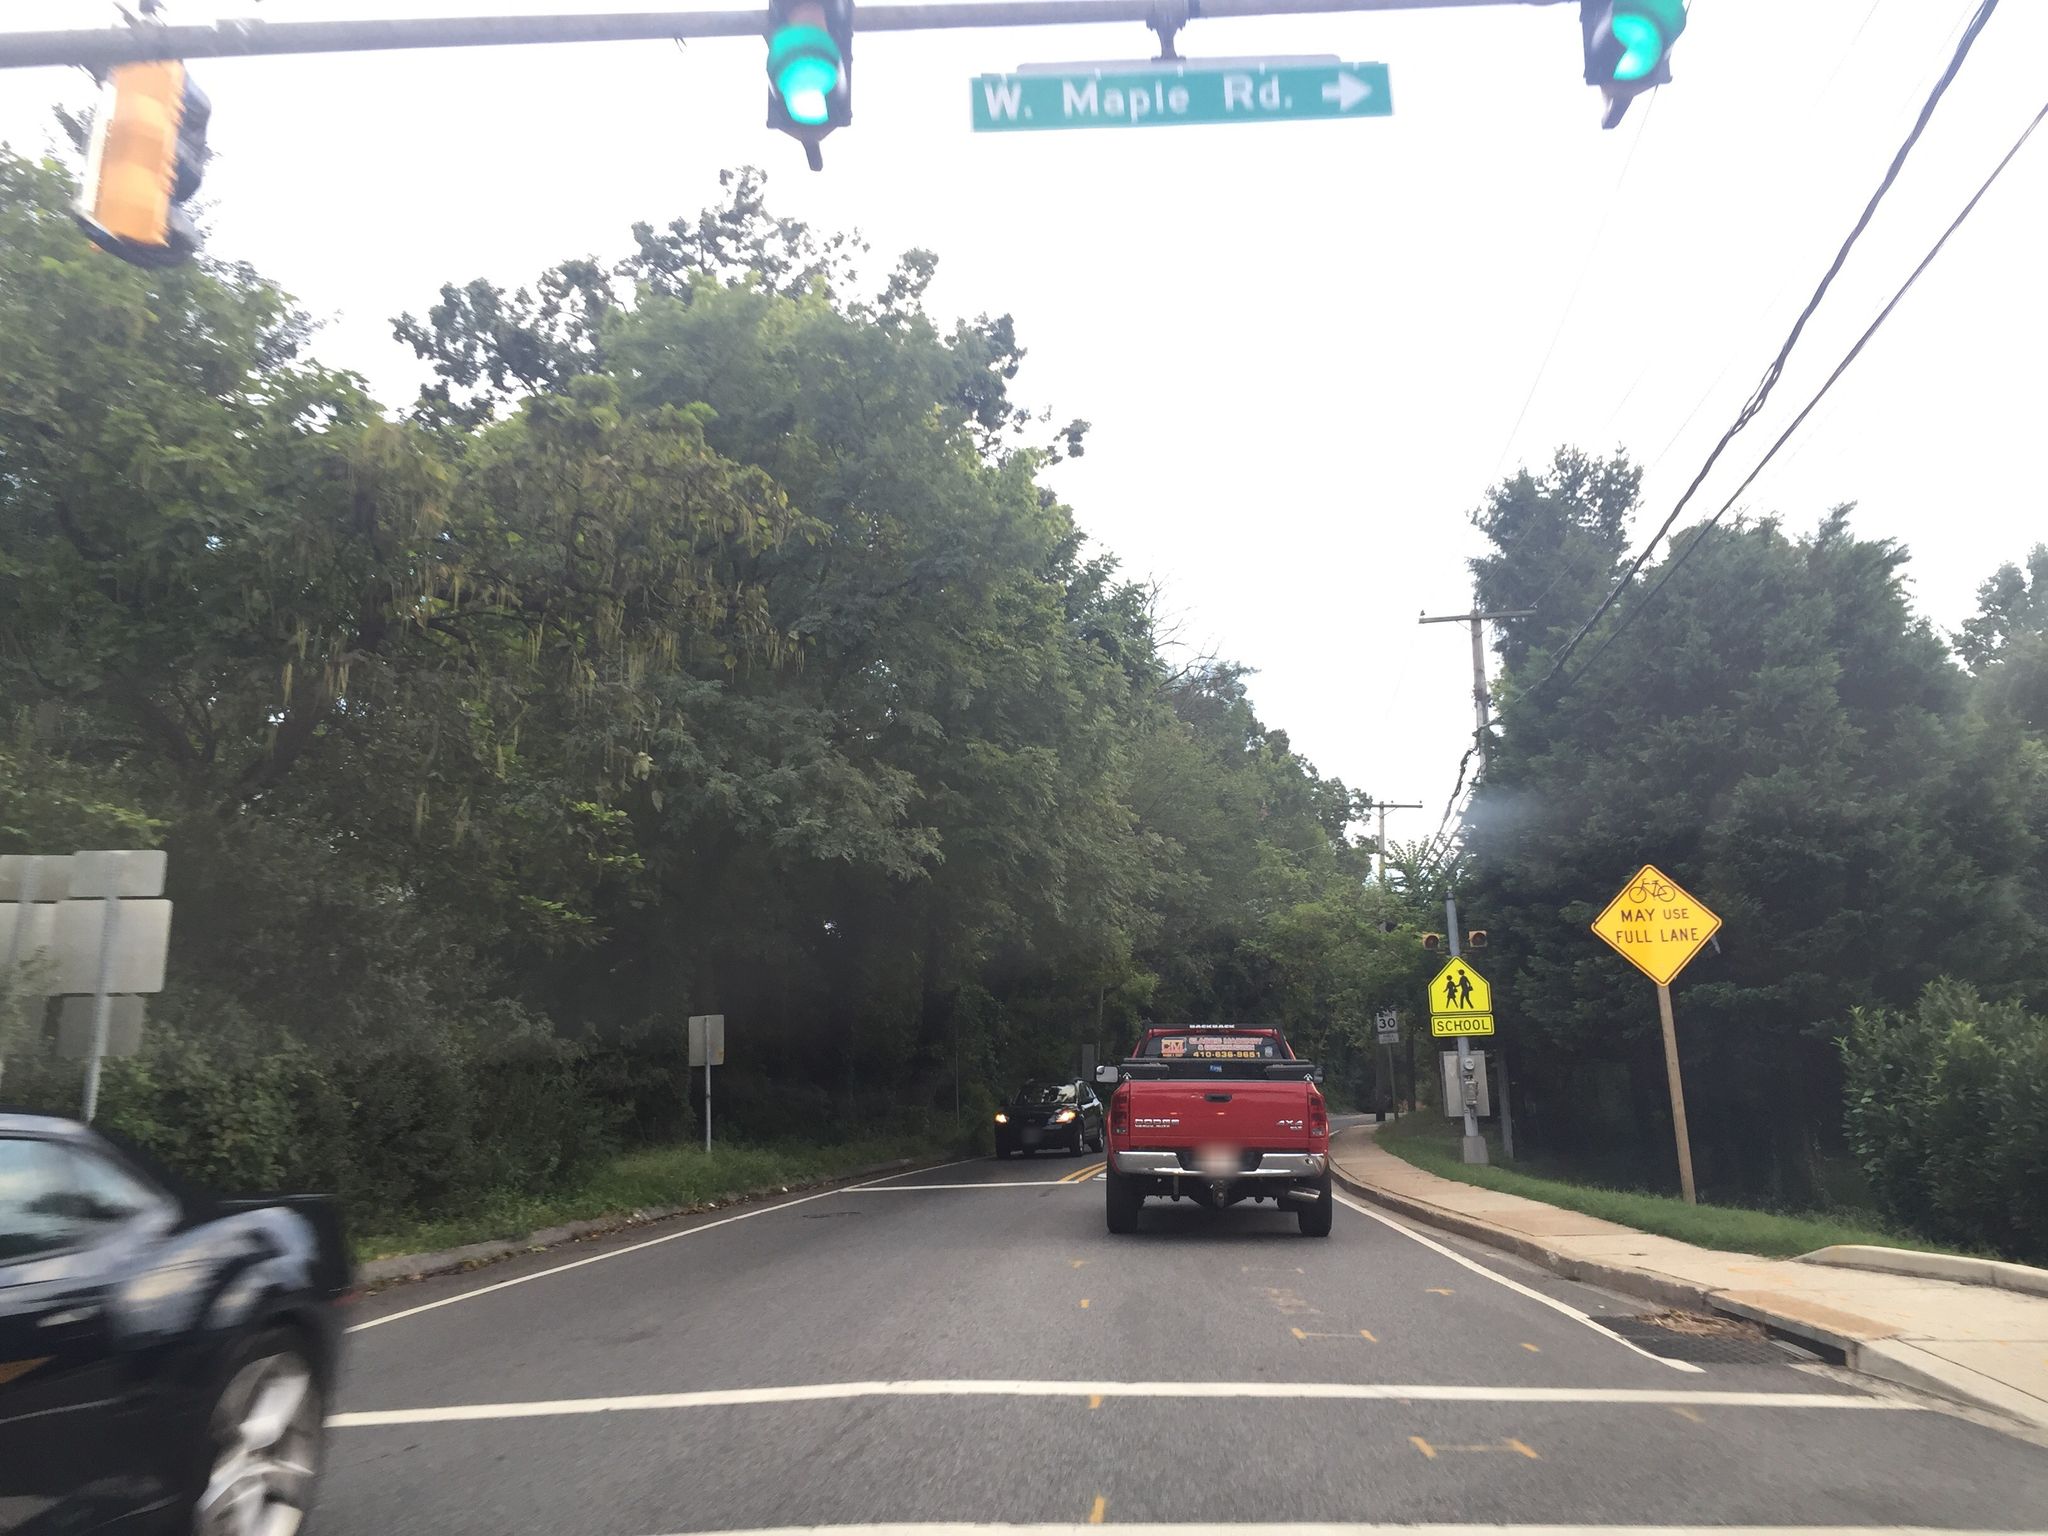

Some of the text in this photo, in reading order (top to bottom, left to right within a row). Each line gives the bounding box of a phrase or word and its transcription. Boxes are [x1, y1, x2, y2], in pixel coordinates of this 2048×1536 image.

[983, 73, 1293, 123] W. Maple Rd.
[1620, 908, 1689, 923] MAY USE
[1616, 927, 1700, 944] FULL LANE
[1379, 1018, 1396, 1029] 30
[1436, 1019, 1490, 1032] SCHOOL
